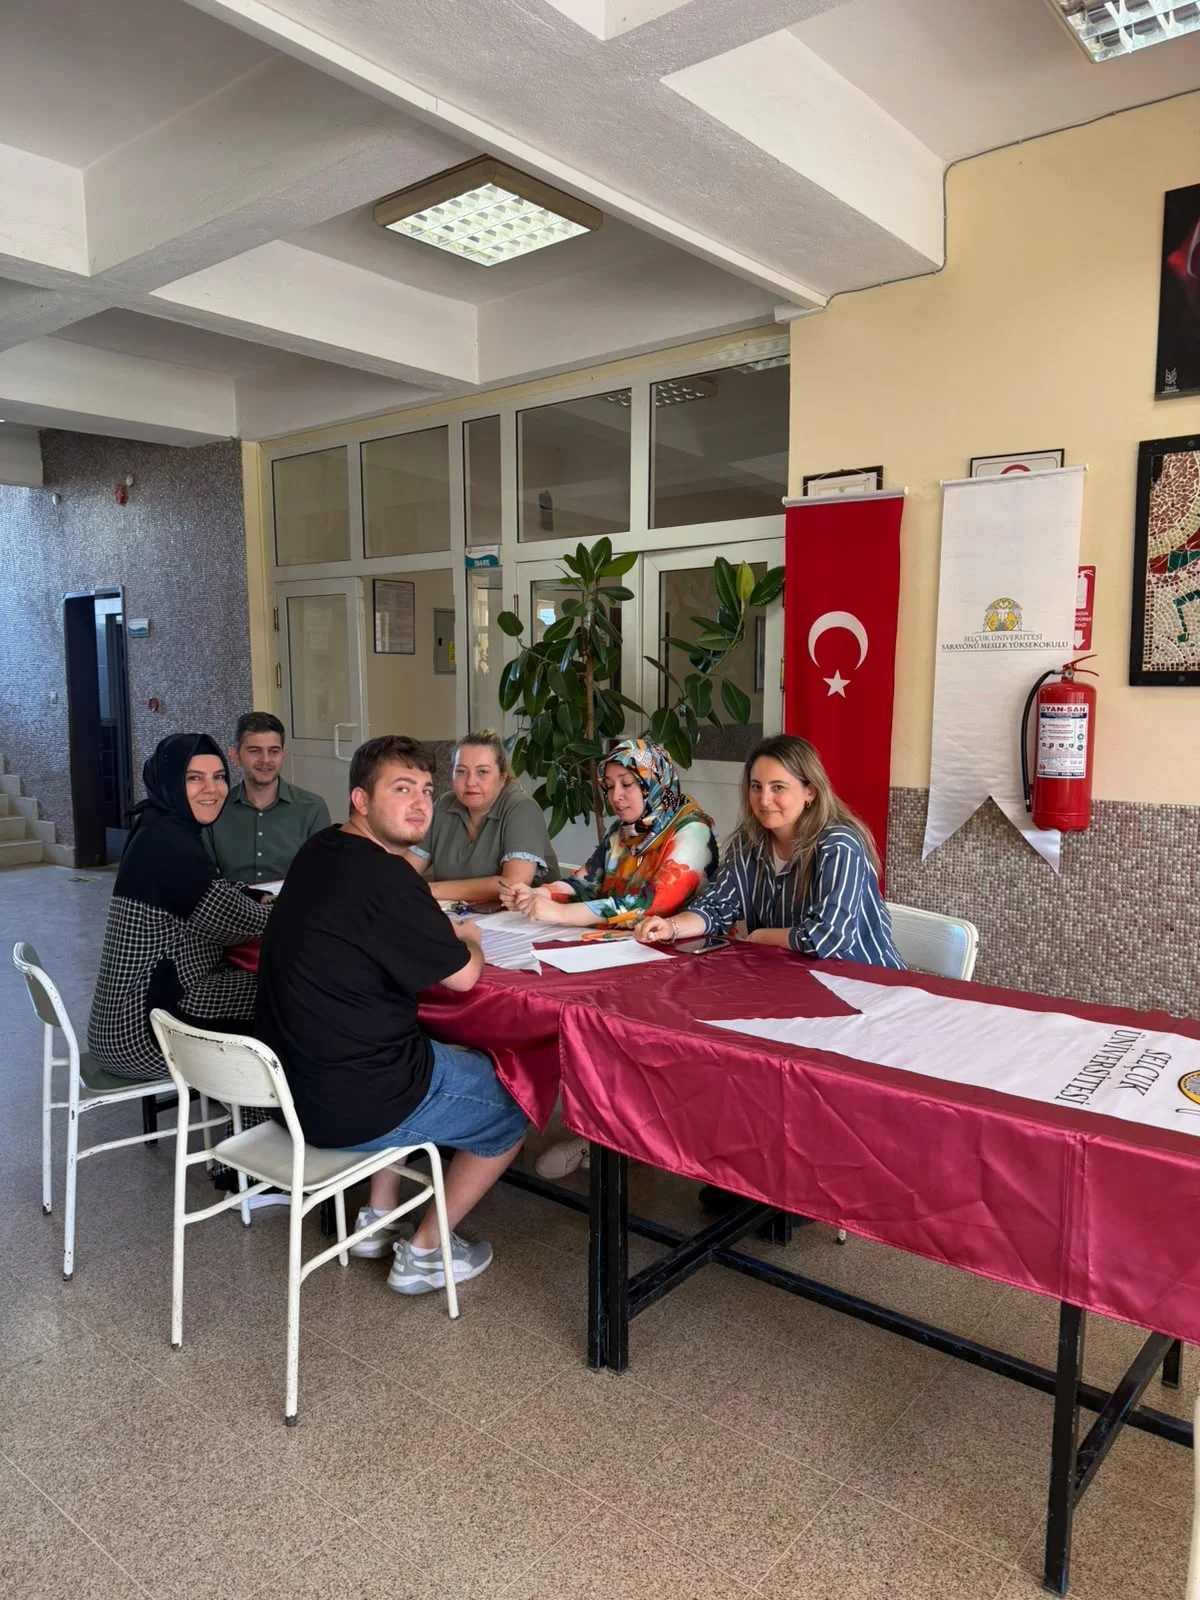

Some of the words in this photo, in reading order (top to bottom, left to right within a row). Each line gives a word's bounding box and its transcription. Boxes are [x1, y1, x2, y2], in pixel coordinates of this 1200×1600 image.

[963, 635, 991, 643] SELÇUK
[981, 641, 1008, 649] MESLEK
[1008, 641, 1069, 649] YÜKSEKOKULU
[1114, 1048, 1172, 1097] SELÇUK
